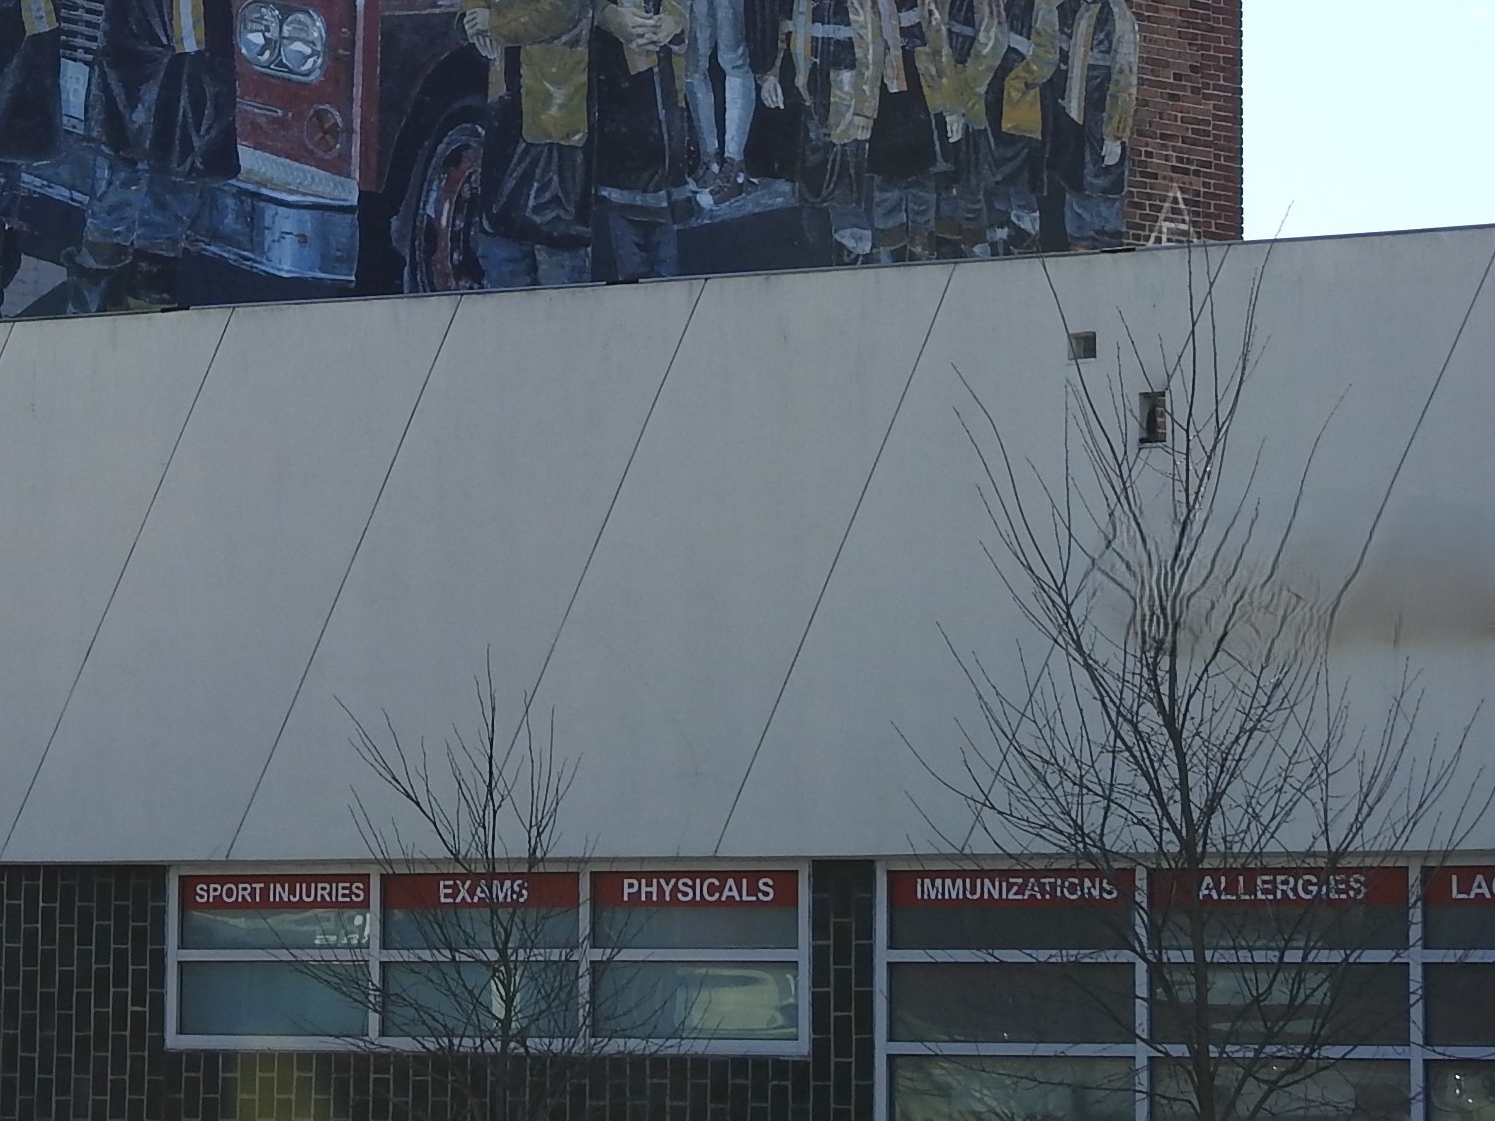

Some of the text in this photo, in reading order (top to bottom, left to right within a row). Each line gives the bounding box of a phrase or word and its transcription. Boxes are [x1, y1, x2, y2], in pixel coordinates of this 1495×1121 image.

[195, 882, 365, 903] SPORT INJURIES
[439, 879, 529, 903] EXAMS
[623, 878, 775, 902] PHYSICALS
[916, 877, 1117, 900] IMMUNIZATIONS
[1451, 874, 1495, 899] LA
